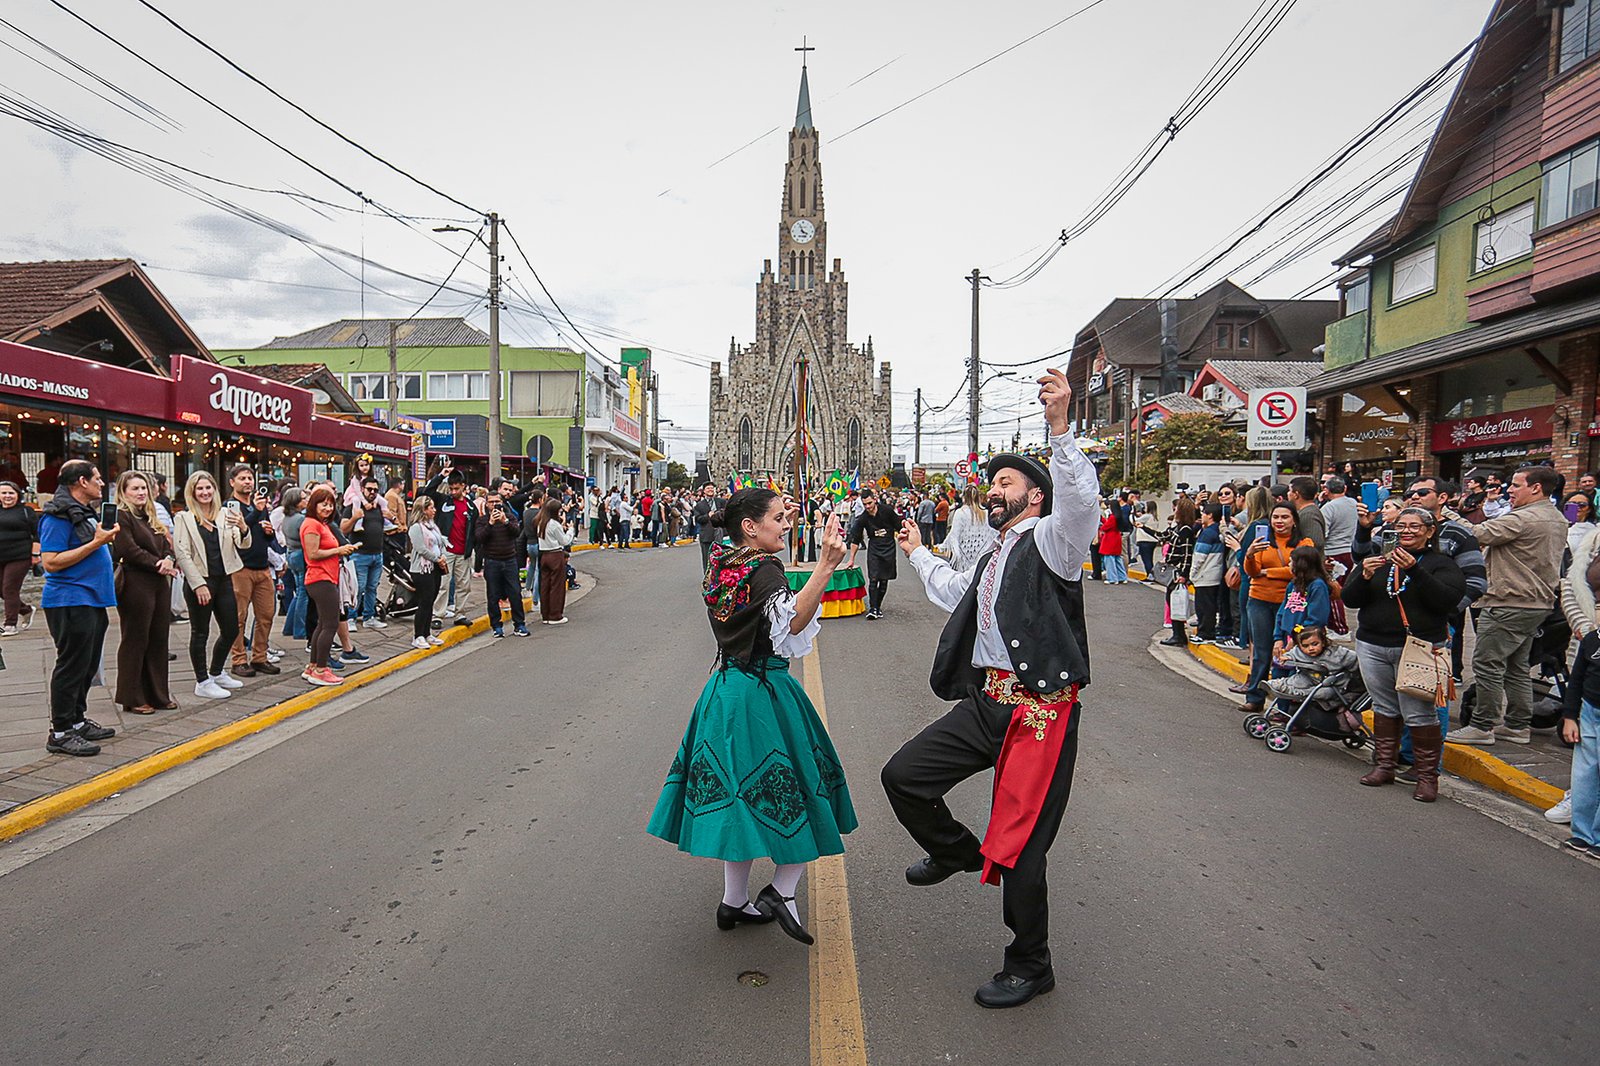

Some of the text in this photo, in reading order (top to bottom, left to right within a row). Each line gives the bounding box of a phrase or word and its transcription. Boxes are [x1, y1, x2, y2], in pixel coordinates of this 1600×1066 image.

[0, 373, 89, 399] ADOS-MASSAS
[1468, 417, 1532, 437] Dolce Monte
